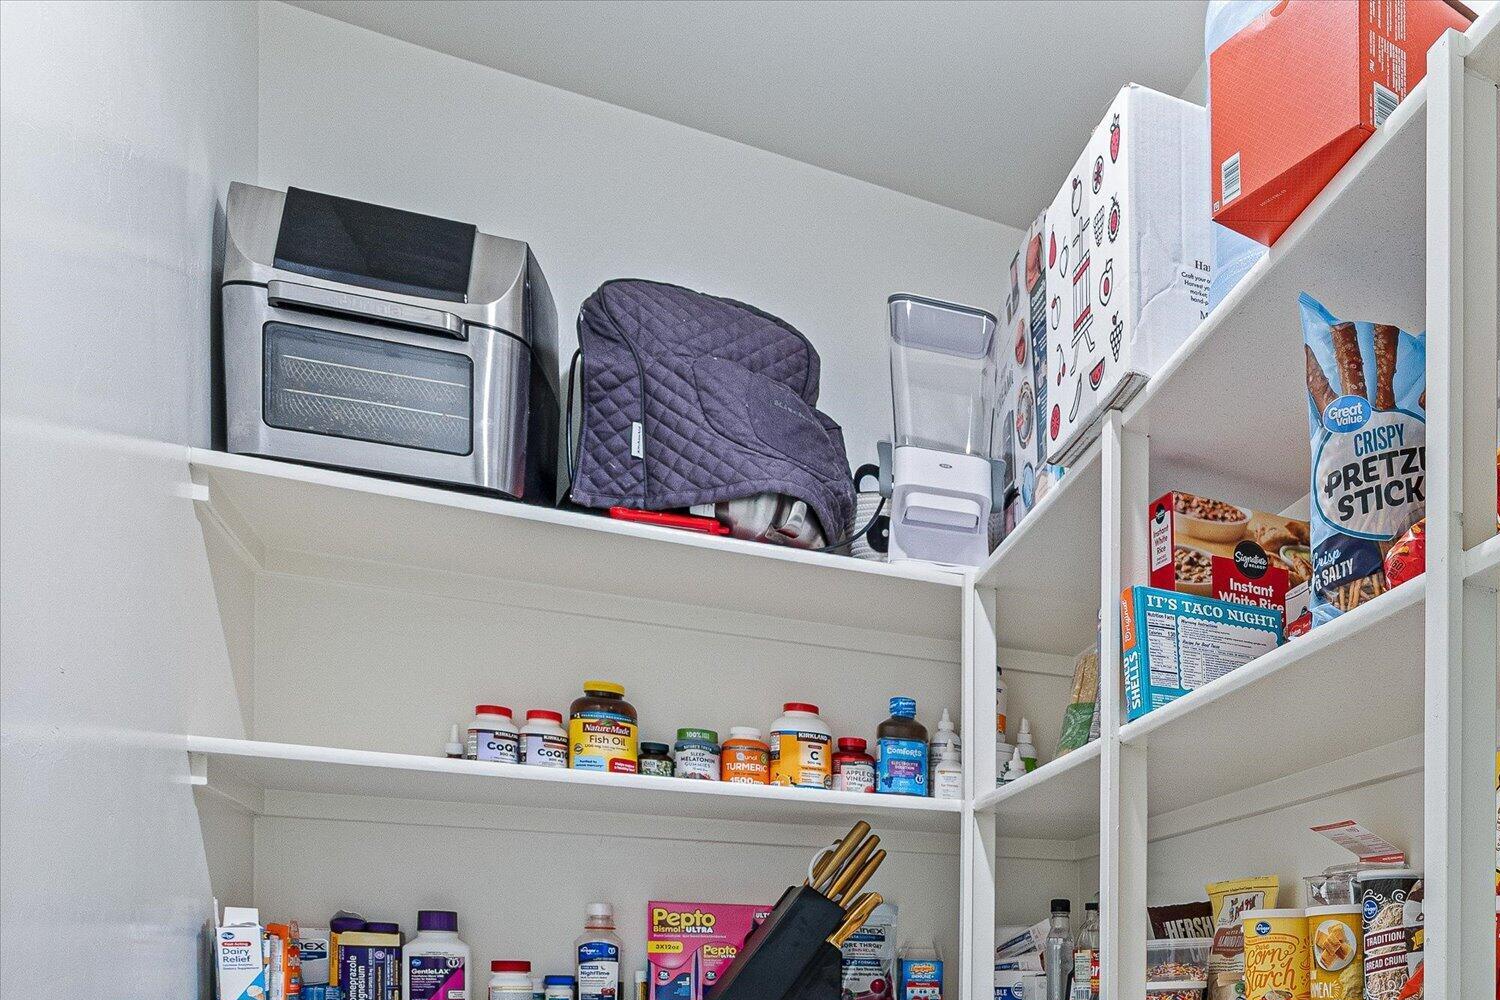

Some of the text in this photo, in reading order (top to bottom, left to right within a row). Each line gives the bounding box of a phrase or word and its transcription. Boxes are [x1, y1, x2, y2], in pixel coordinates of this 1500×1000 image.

[1194, 275, 1206, 283] your
[1329, 402, 1362, 420] Great
[1336, 414, 1362, 426] Value
[1354, 424, 1404, 456] CRISPY
[1324, 447, 1425, 499] PRETZ
[1338, 476, 1425, 521] STICK
[1157, 546, 1165, 554] Rice
[1323, 559, 1353, 585] SALTY
[1230, 579, 1273, 597] Instant
[1219, 591, 1284, 613] White Rice
[1147, 595, 1278, 628] IT'S TACO NIGHT.
[1130, 651, 1140, 709] SHELLS
[590, 735, 625, 746] Fish Oil
[798, 732, 828, 741] KIRKLAND
[680, 756, 715, 764] MELATONIN
[810, 750, 818, 760] C
[726, 763, 767, 772] TURMERIC
[653, 908, 715, 929] Pepto
[222, 948, 249, 957] Dairy
[703, 945, 736, 955] Pepto
[1366, 958, 1384, 971] BREAD
